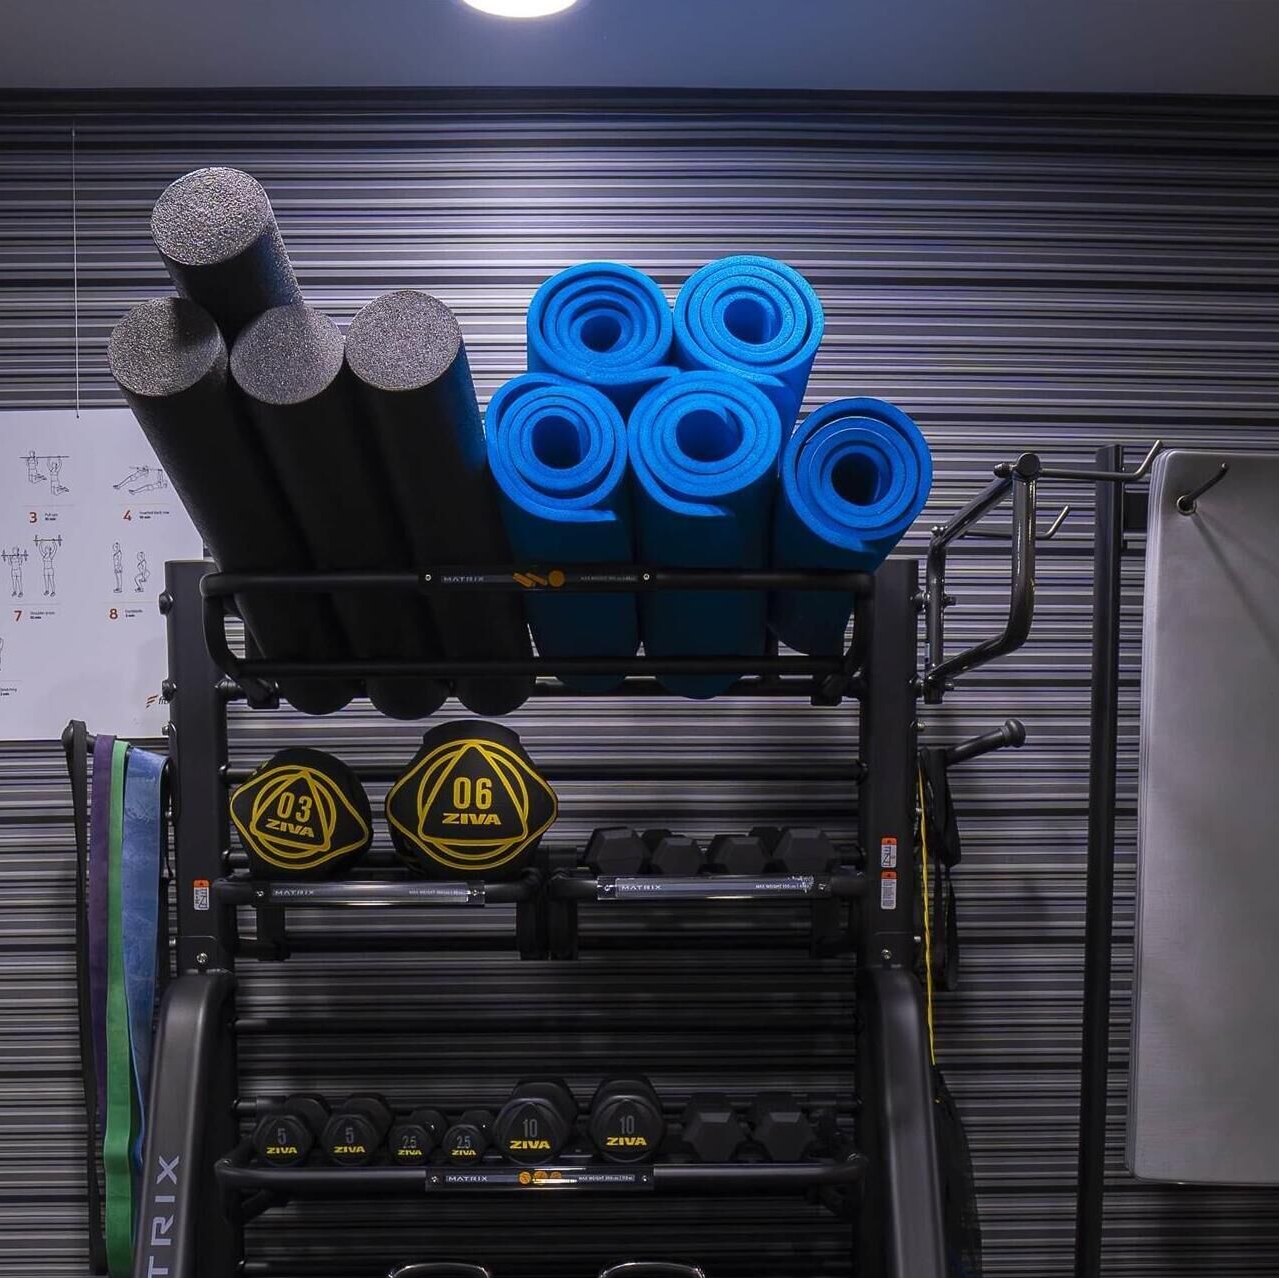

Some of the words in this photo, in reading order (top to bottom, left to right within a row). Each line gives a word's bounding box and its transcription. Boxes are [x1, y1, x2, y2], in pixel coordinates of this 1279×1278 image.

[29, 512, 37, 523] 3
[123, 510, 131, 521] 4
[14, 611, 22, 621] 7
[109, 608, 118, 619] 8
[453, 776, 492, 810] 06
[276, 792, 313, 822] 03
[441, 812, 502, 825] ZIVA
[265, 818, 315, 838] ZIVA
[522, 1118, 538, 1138] 10
[620, 1115, 635, 1134] 10
[277, 1128, 287, 1144] 5
[345, 1127, 353, 1144] 5
[606, 1137, 647, 1146] ZIVA
[265, 1146, 298, 1155] ZIVA
[333, 1146, 366, 1154] ZIVA
[509, 1140, 551, 1149] ZIVA
